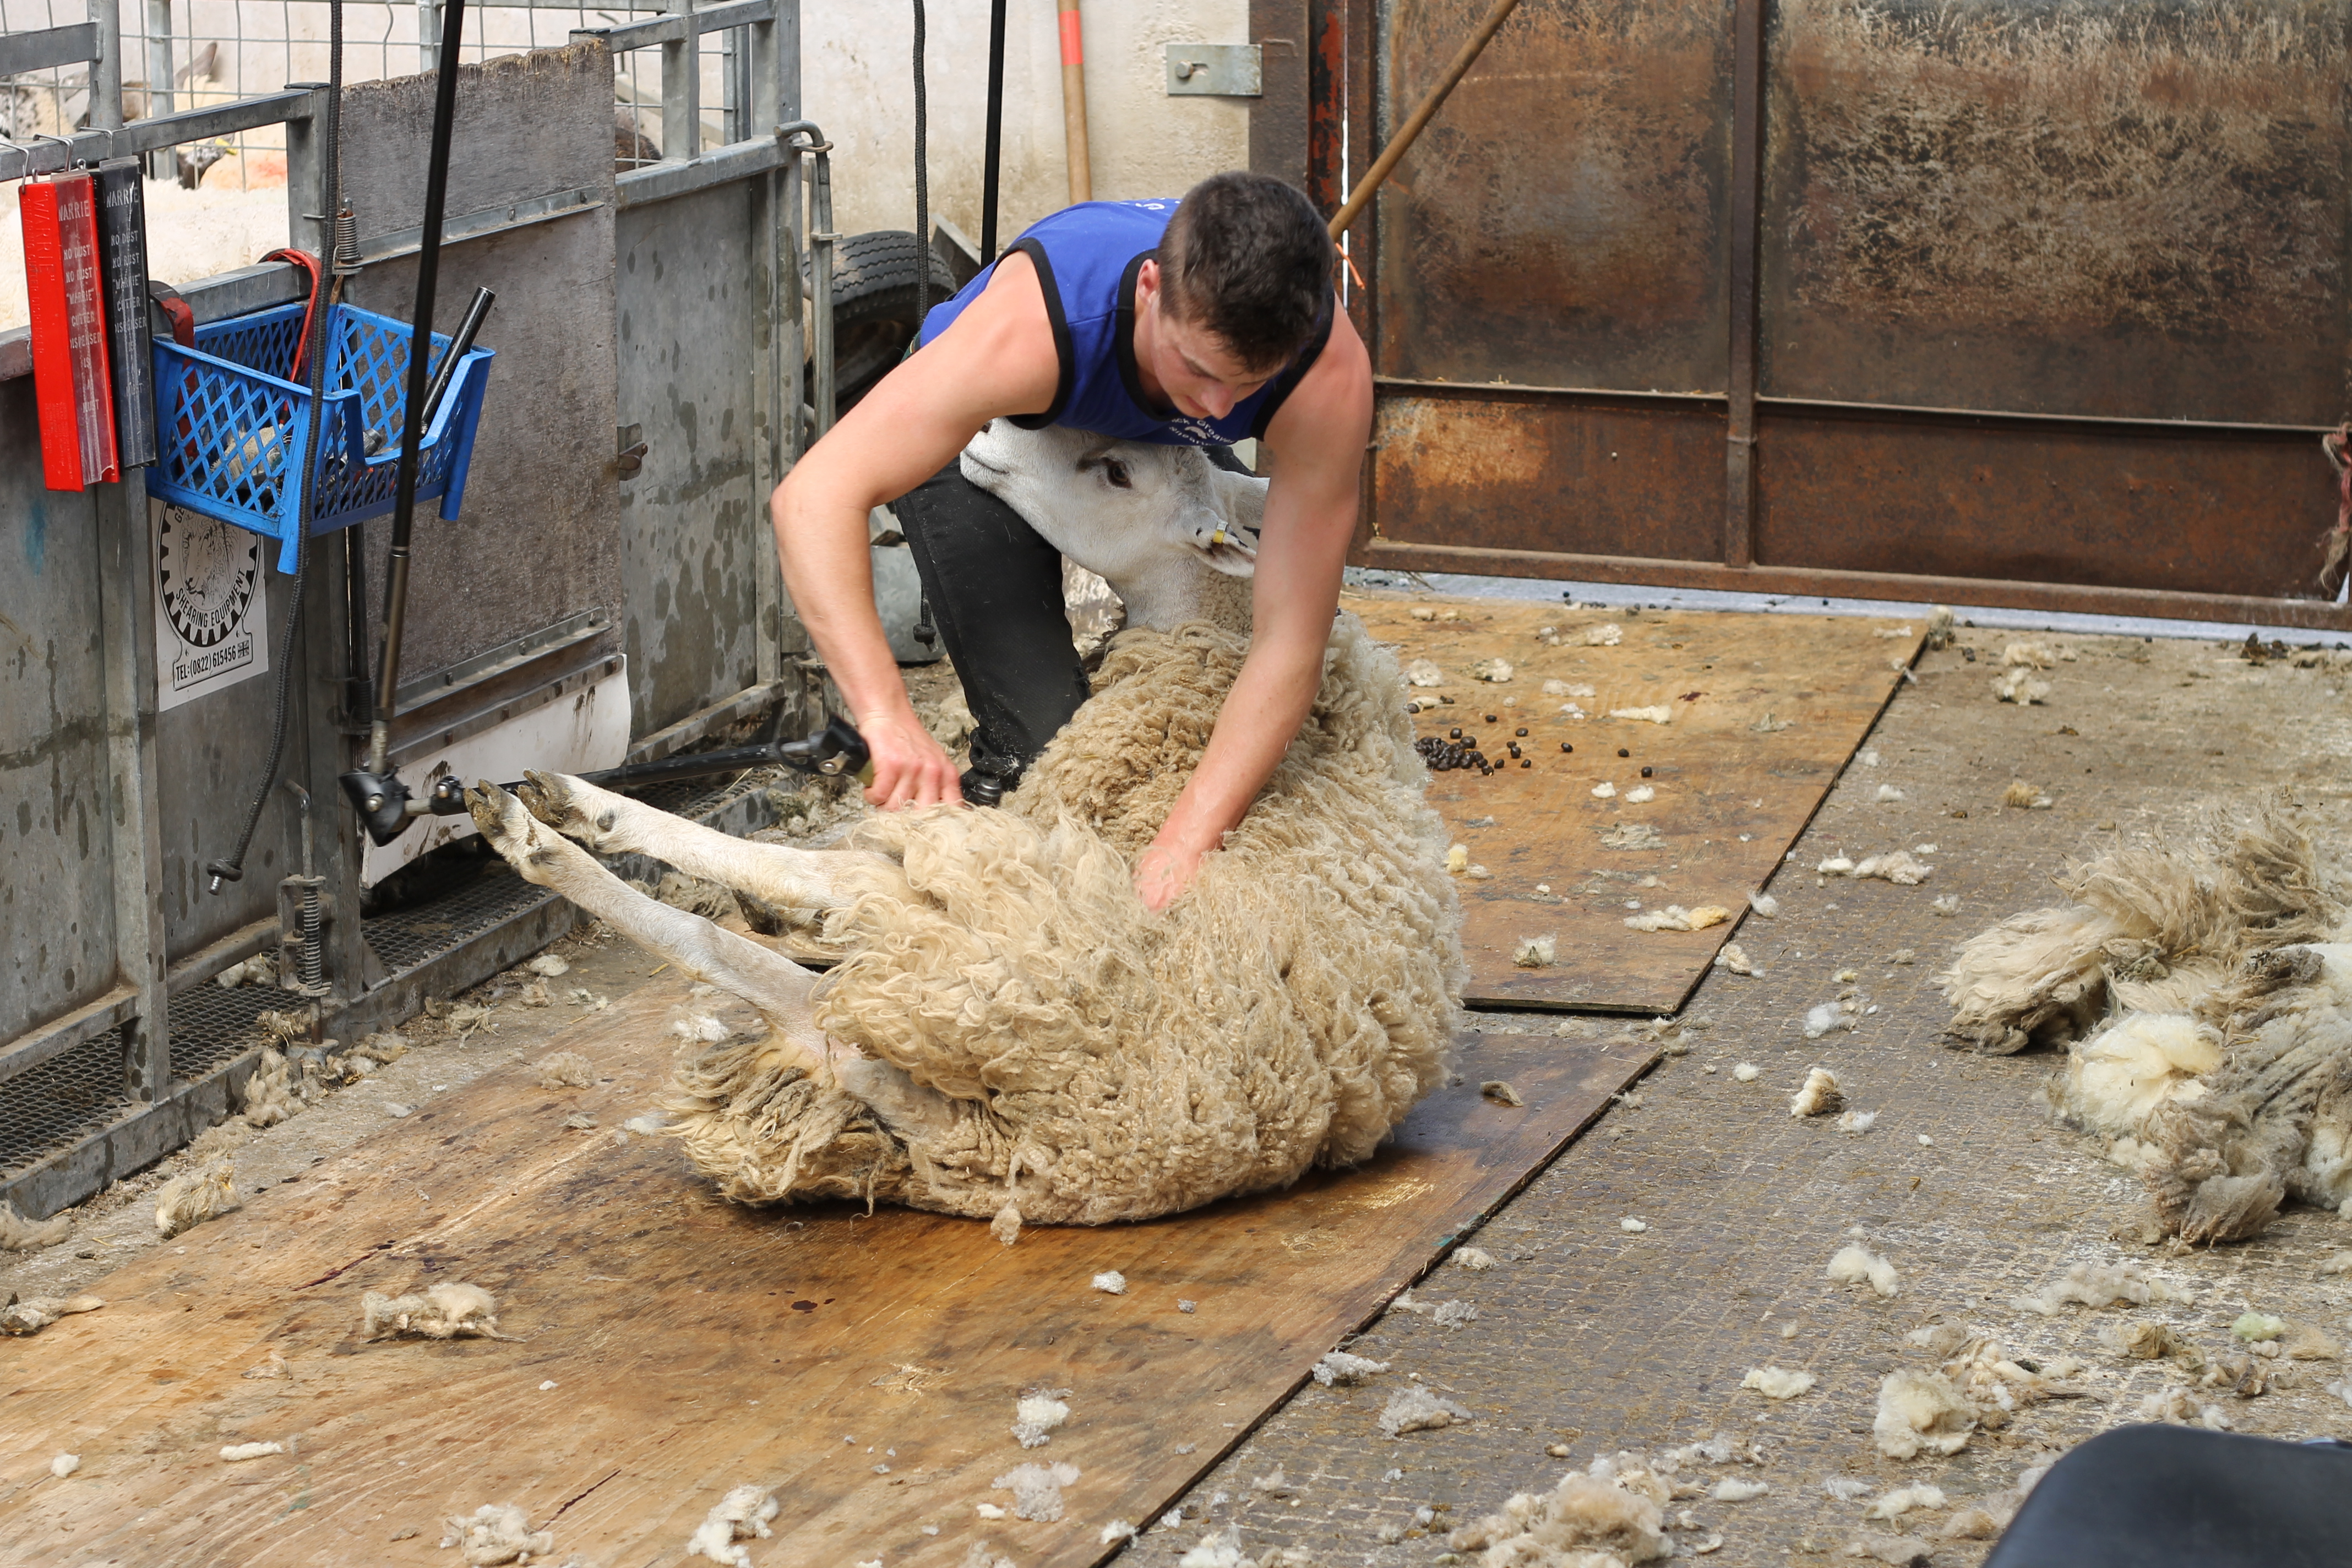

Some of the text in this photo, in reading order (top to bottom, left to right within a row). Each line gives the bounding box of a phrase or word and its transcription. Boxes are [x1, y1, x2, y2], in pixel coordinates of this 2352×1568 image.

[111, 231, 138, 246] NO DUST
[63, 244, 90, 260] NO DUST
[112, 253, 139, 269] NO RUST
[66, 271, 75, 283] NO
[176, 568, 246, 628] SHEARING EQUIPMENT
[213, 645, 236, 667] 615456
